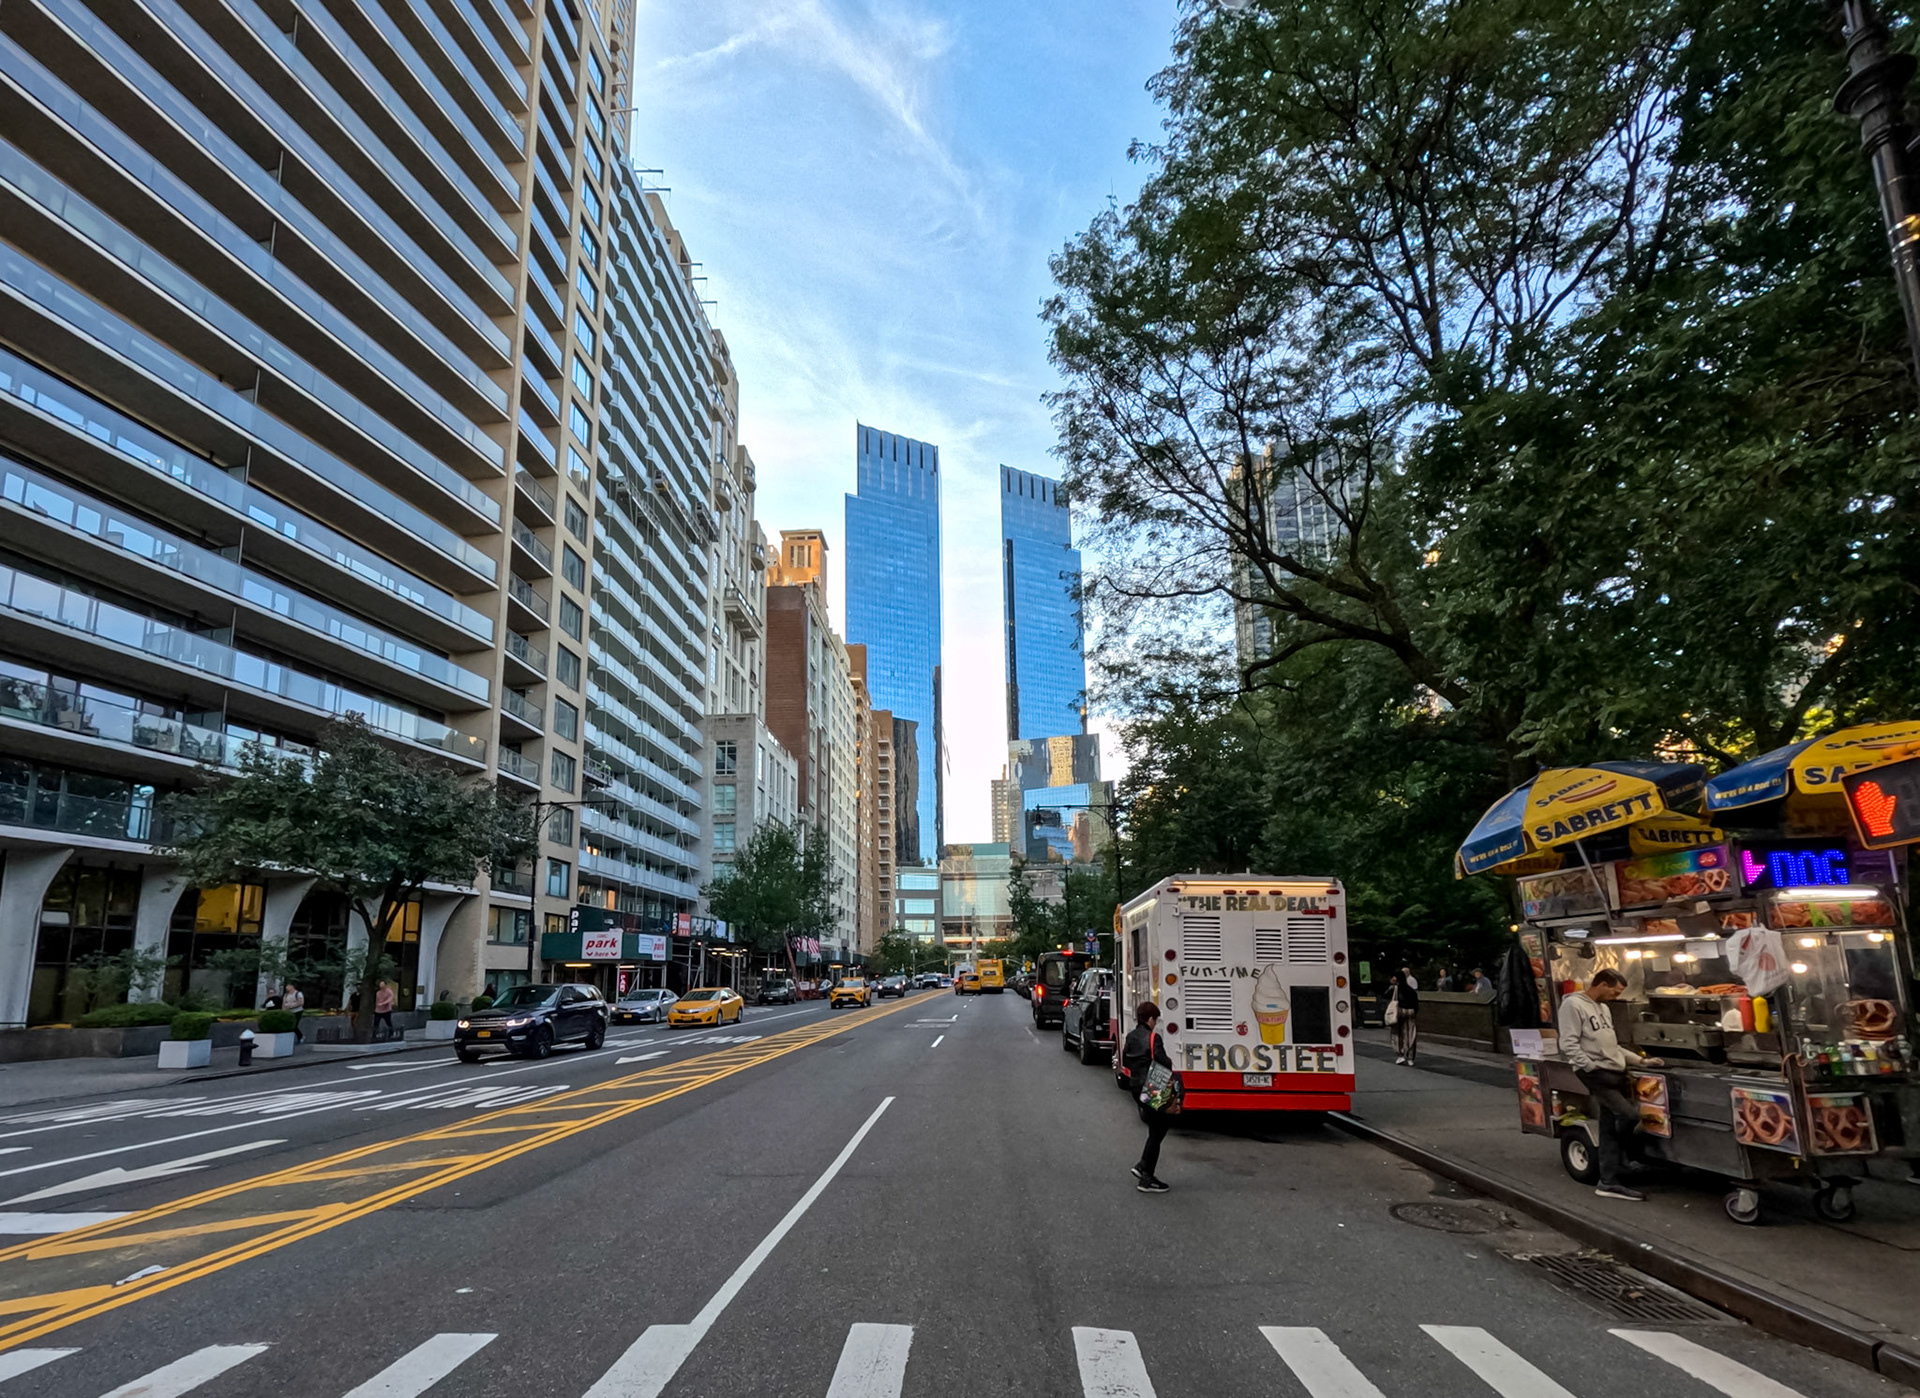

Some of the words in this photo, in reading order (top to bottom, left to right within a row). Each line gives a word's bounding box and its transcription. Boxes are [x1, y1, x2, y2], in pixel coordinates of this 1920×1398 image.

[1535, 774, 1602, 808] SABRETT
[1535, 792, 1653, 842] SABRETT
[1226, 896, 1270, 911] REAL
[585, 938, 617, 949] park
[1185, 1043, 1336, 1072] FROSTEE
